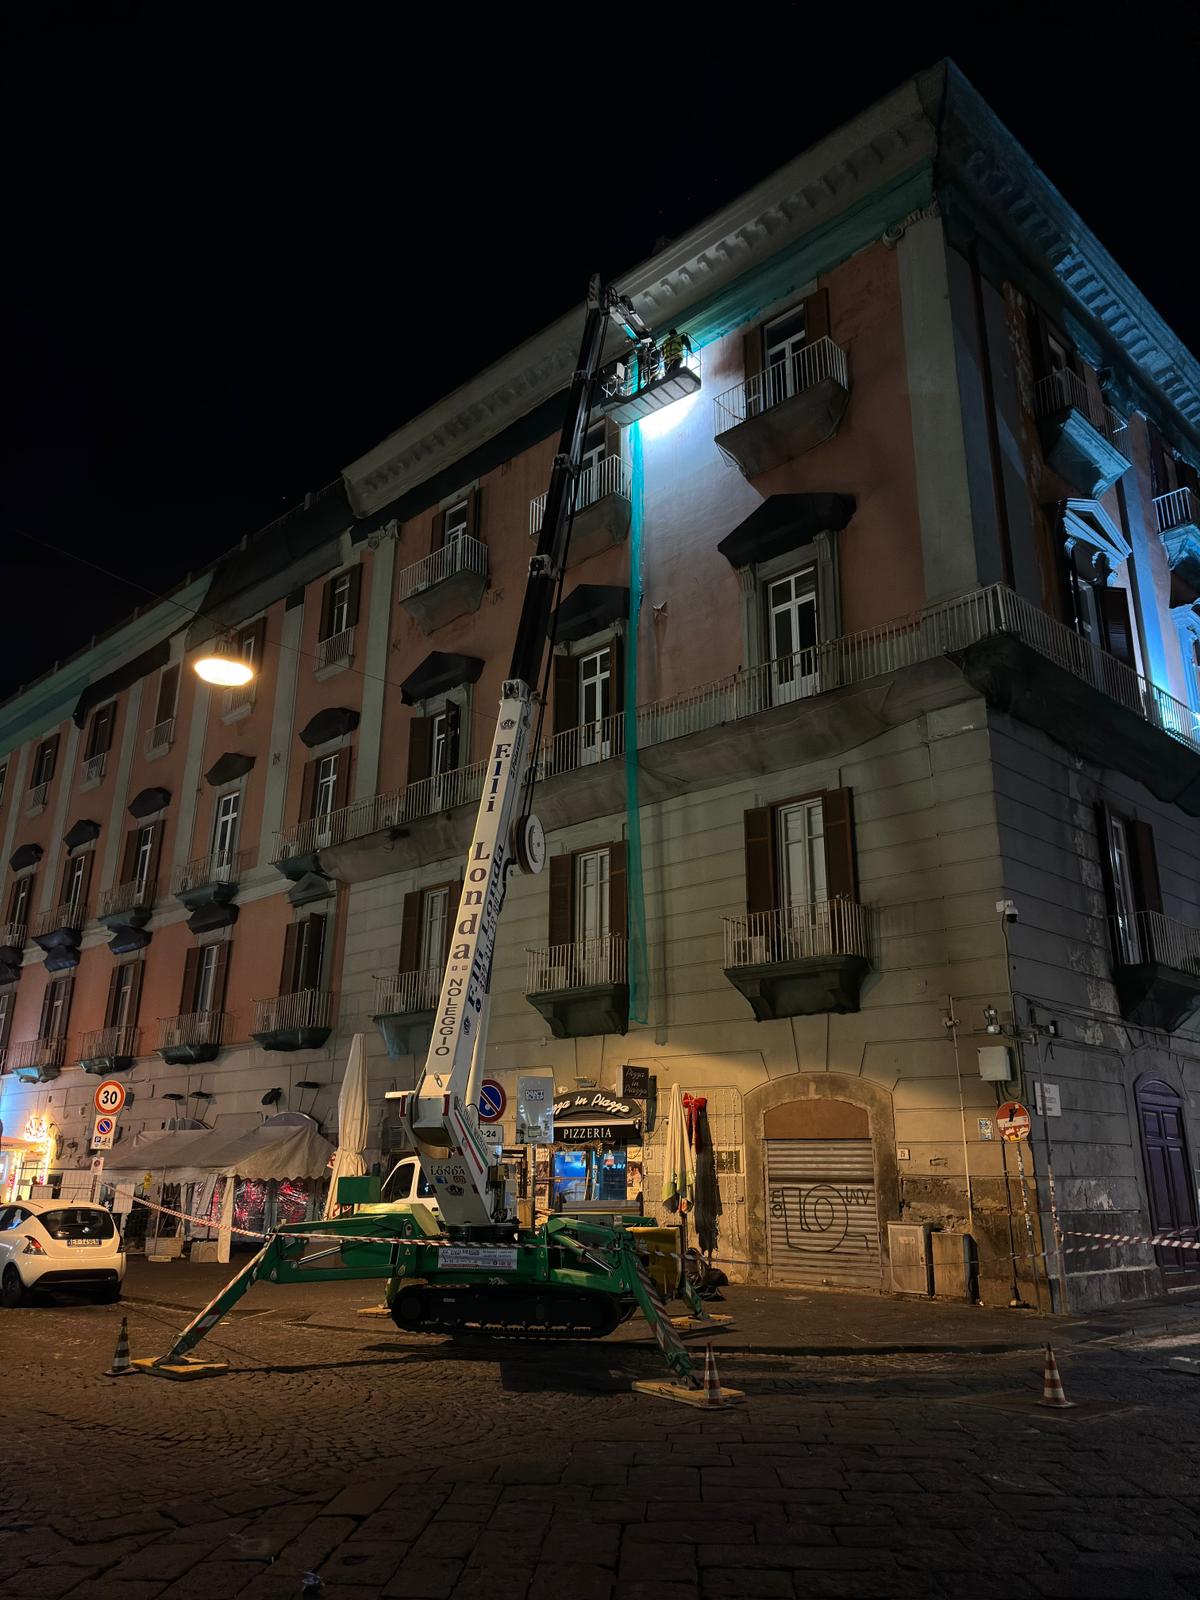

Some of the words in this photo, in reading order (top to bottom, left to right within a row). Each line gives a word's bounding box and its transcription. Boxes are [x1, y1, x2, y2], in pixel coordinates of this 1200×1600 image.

[453, 841, 490, 960] Londa
[435, 978, 463, 1057] NOLEGGIO
[102, 1090, 118, 1105] 30
[575, 1095, 588, 1106] in
[591, 1093, 630, 1113] Piazza
[563, 1127, 612, 1139] PIZZERIA
